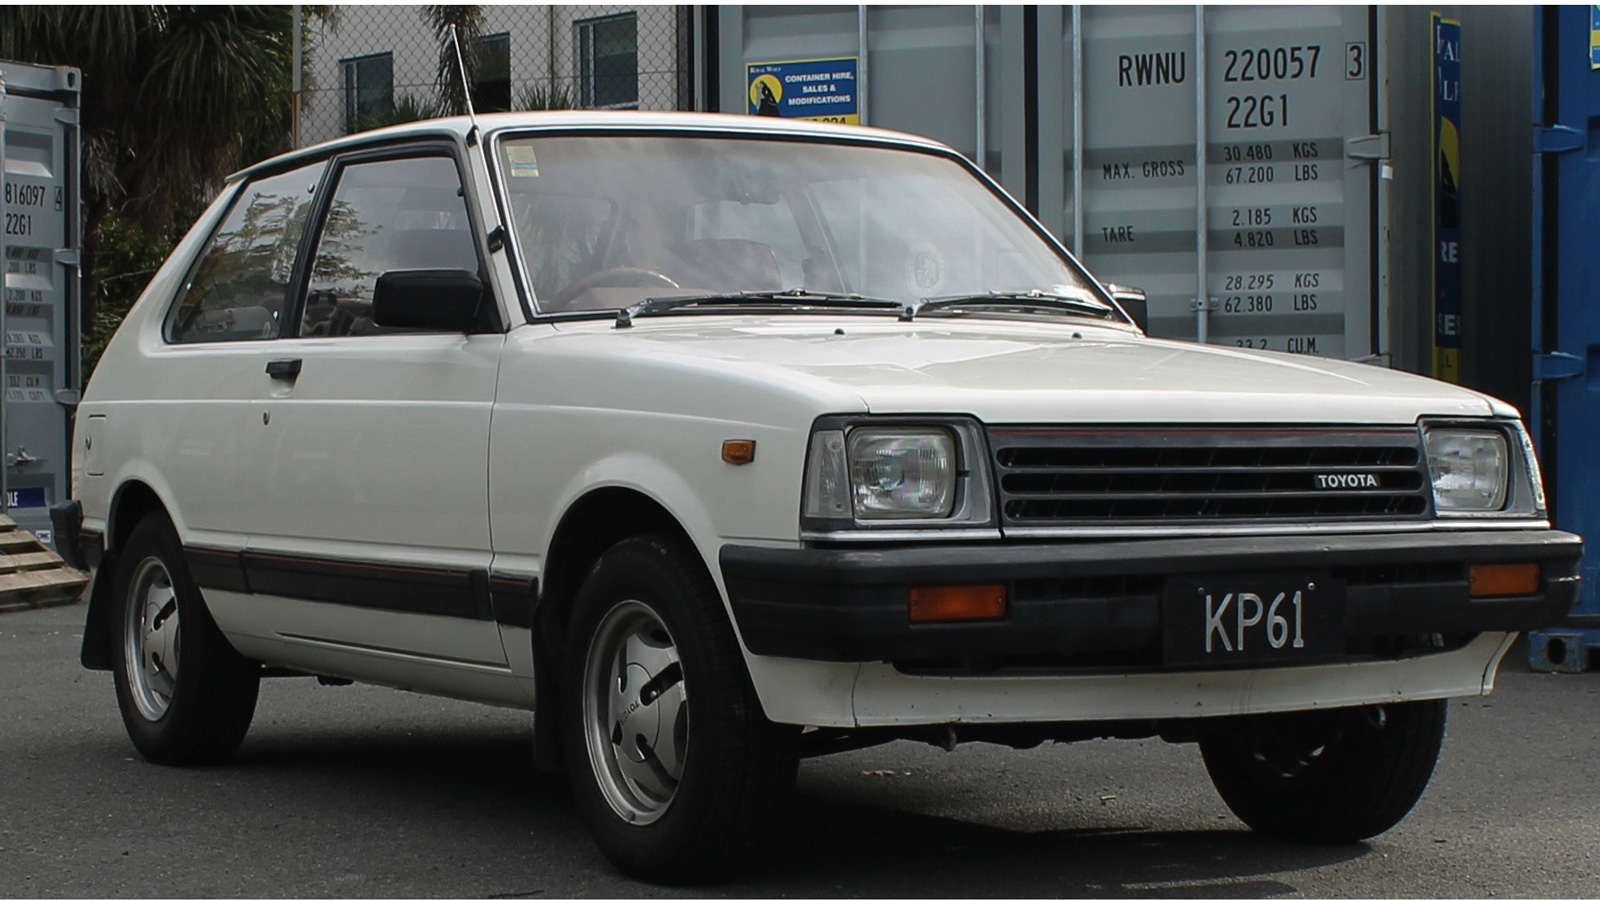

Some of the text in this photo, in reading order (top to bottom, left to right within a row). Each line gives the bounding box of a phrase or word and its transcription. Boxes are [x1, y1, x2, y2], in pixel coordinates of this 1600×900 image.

[1118, 44, 1363, 87] RWNU 220057 3
[785, 71, 854, 83] CONTAINER HIRE,
[802, 84, 836, 93] SALES &
[788, 95, 851, 106] MODIFICATIONS
[1226, 94, 1288, 129] 22G1
[1224, 142, 1319, 162] 30.480 KGS
[1102, 159, 1185, 180] MAX. GROSS
[1225, 164, 1318, 184] 67.200 LBS
[5, 182, 46, 207] 816097
[5, 213, 32, 236] 22G1
[1232, 206, 1318, 226] 2.185 KGS
[1102, 225, 1135, 243] TARE
[1233, 229, 1319, 248] 4.820 LBS
[1225, 273, 1320, 291] 28.295 KGS
[1224, 294, 1317, 313] 62.380 LBS
[1317, 474, 1378, 488] TOYOTA
[1205, 590, 1304, 653] KP61
